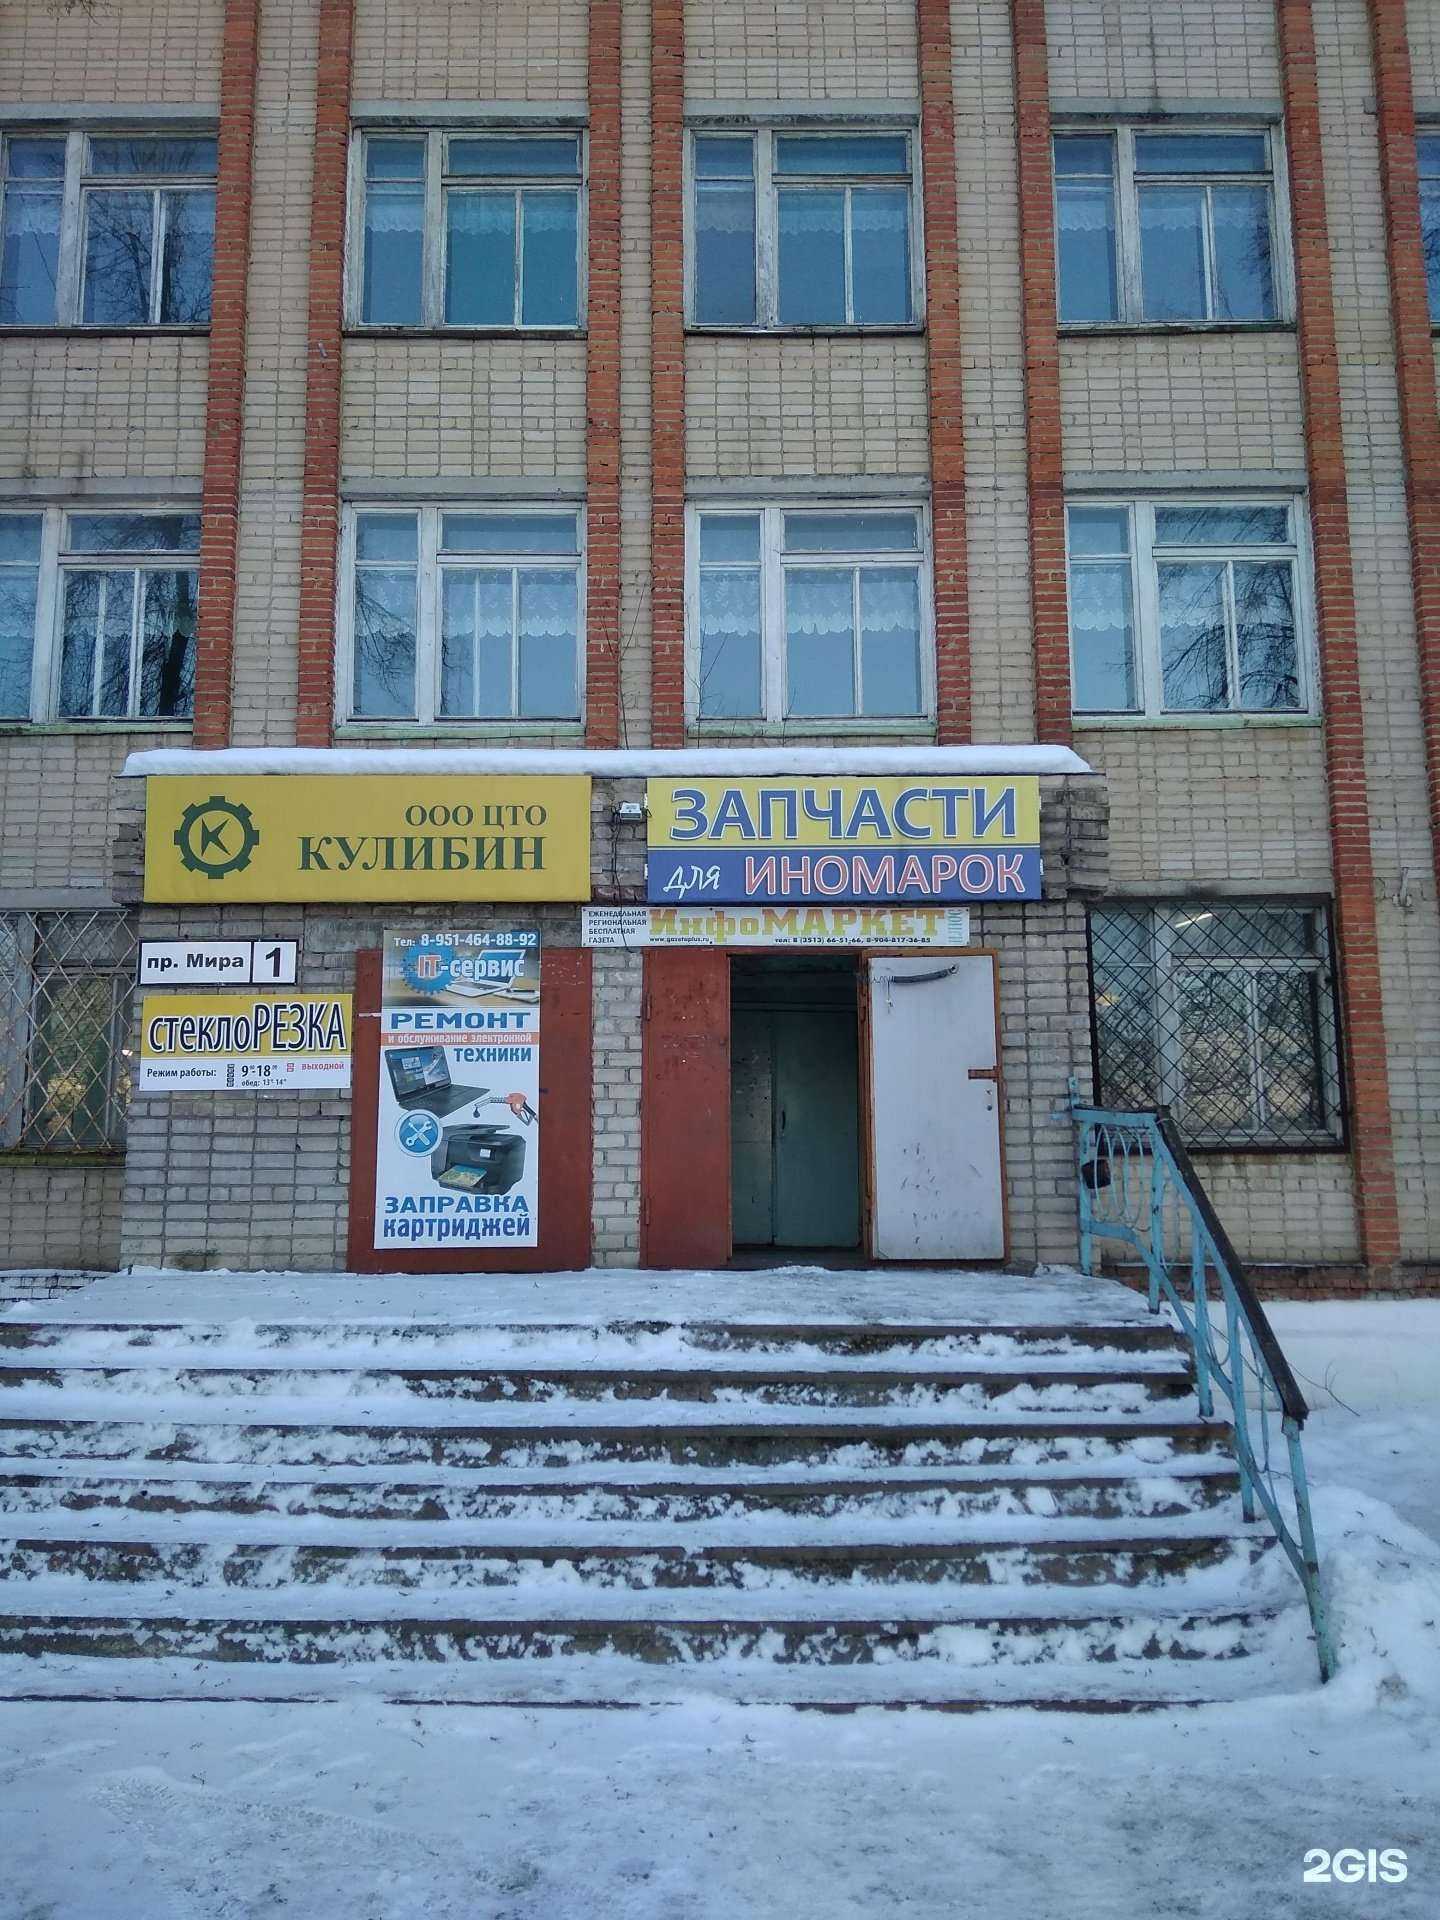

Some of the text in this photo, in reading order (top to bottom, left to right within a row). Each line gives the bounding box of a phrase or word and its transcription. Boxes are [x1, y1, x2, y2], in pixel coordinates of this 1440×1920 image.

[405, 804, 547, 831] ООО ЦТО
[670, 787, 1016, 840] ЗАПЧАСТИ
[297, 836, 547, 871] КУЛИБИН
[744, 853, 1025, 895] ИНОМАРОК
[588, 910, 647, 918] ЕЖЕНЕДЕЛЬНАЯ
[650, 908, 945, 944] ИнфоМАРКЕТ
[394, 933, 537, 947] Тел: 8-951-464-88-92
[147, 953, 244, 972] пр. Мира
[265, 947, 281, 978] 1
[417, 954, 525, 980] IT-сервис
[149, 1002, 347, 1052] стеклоРЕЗКА
[391, 1012, 531, 1029] РЕМОНТ
[388, 1033, 532, 1044] и обслуживание электронной
[453, 1048, 532, 1062] техники
[147, 1068, 178, 1078] Режим
[179, 1067, 217, 1079] работы:
[384, 1195, 529, 1214] ЗАПРАВКА
[383, 1213, 530, 1241] картриджей
